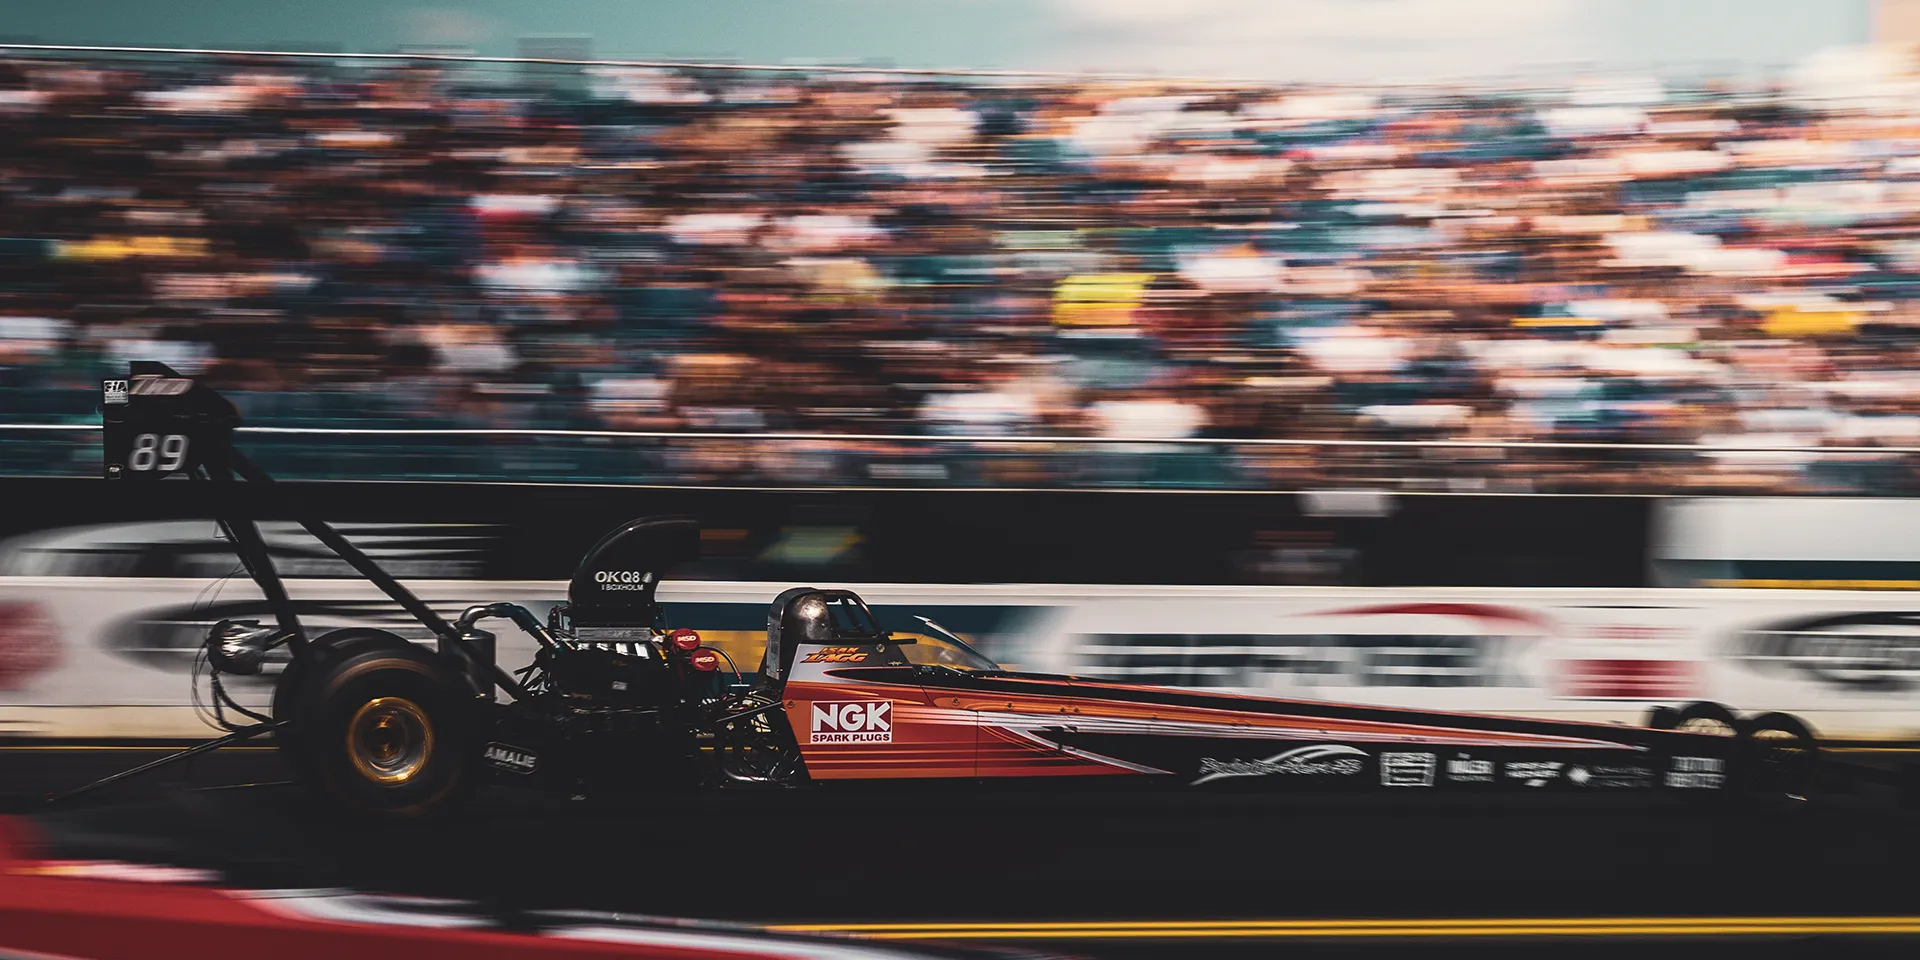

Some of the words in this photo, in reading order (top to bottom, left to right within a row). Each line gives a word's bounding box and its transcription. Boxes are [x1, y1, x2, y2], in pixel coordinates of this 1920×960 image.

[129, 433, 190, 471] 89
[812, 702, 891, 731] NGK
[812, 734, 849, 742] SPARK
[852, 734, 890, 742] PLUGS
[484, 747, 536, 767] AMALIE
